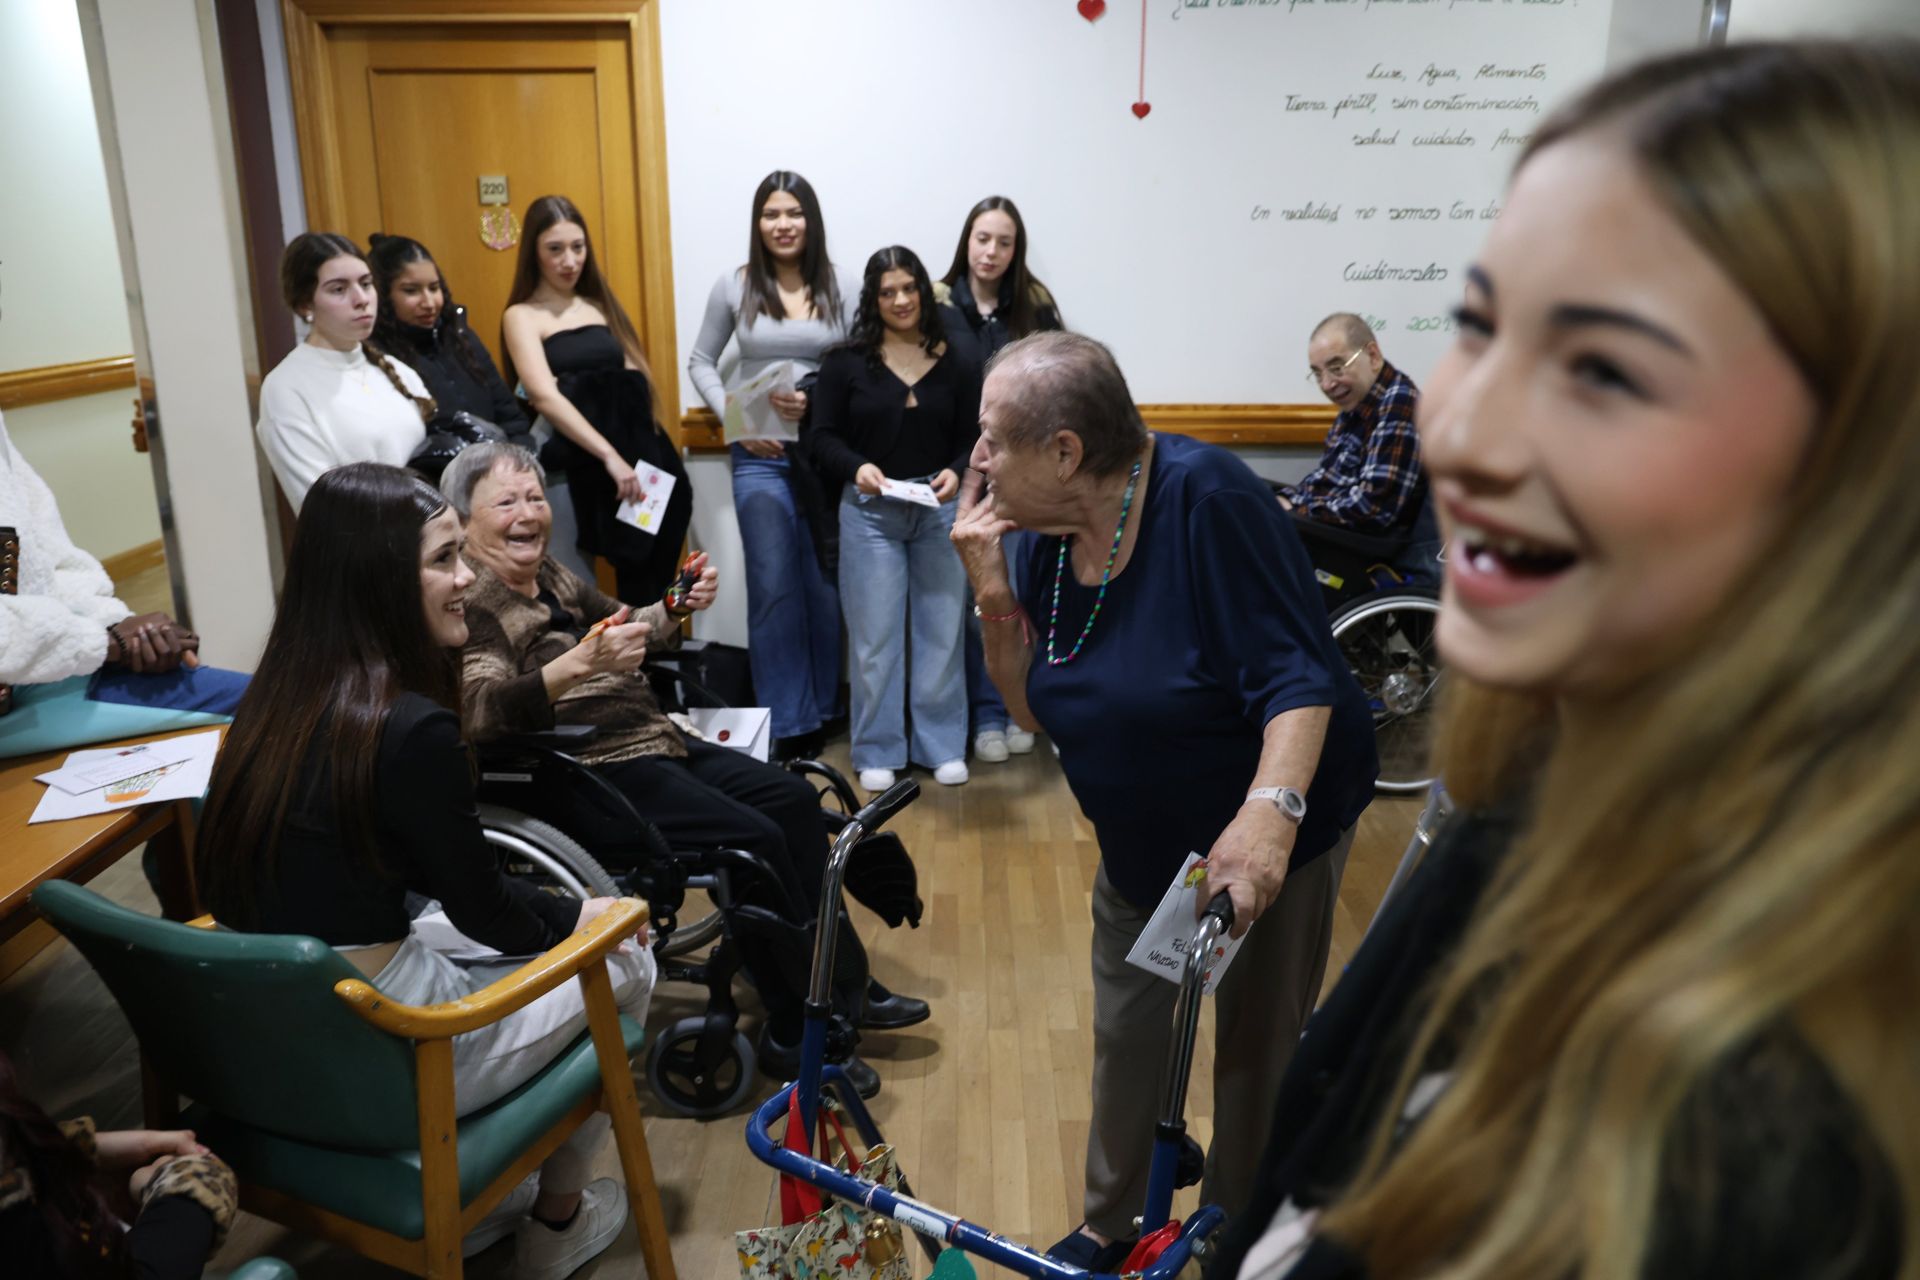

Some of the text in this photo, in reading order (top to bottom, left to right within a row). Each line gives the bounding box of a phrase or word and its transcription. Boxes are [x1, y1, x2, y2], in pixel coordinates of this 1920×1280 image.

[1418, 62, 1460, 87] Agua,
[1474, 63, 1546, 81] Alimento,
[1284, 94, 1328, 111] Tierra
[1391, 96, 1419, 110] sin
[1423, 93, 1540, 113] contaminación,
[1352, 127, 1532, 151] salud cuidados Amo
[482, 183, 505, 195] 220
[1250, 203, 1271, 221] En
[1281, 200, 1342, 222] realidad
[1355, 206, 1377, 220] no
[1388, 207, 1441, 221] somos
[1448, 200, 1475, 220] tan
